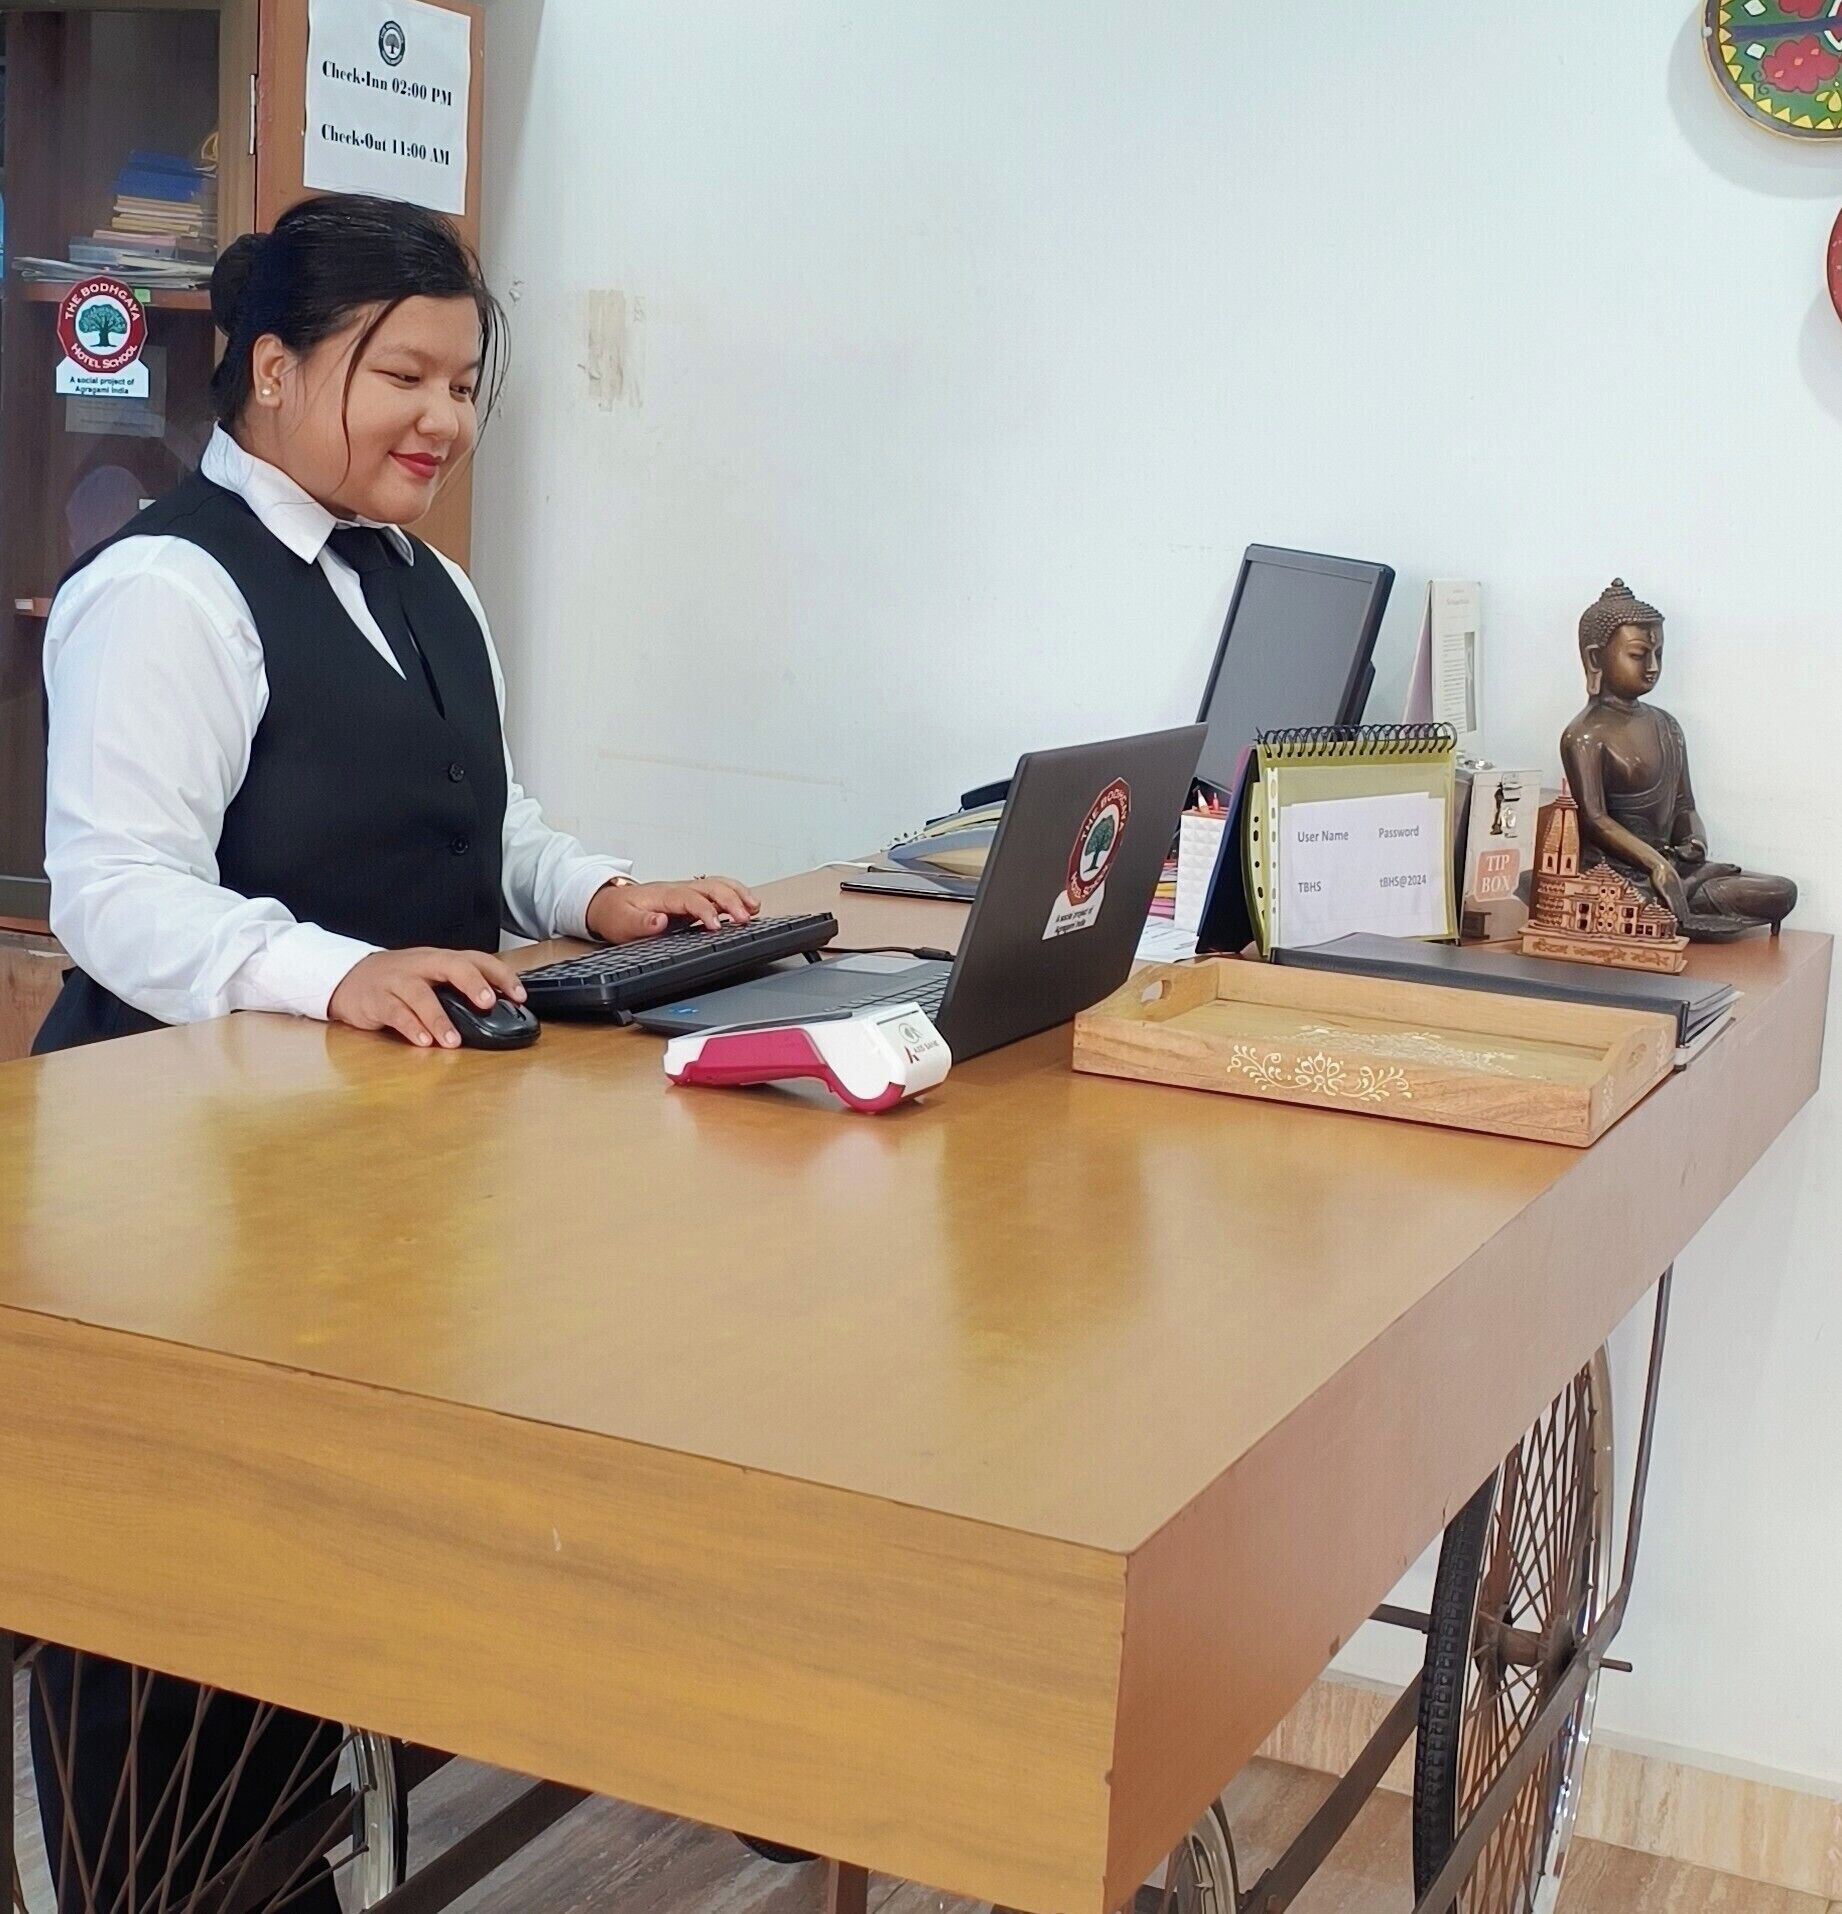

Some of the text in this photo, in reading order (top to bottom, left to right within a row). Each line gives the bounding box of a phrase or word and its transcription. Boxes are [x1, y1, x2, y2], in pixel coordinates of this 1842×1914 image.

[322, 60, 452, 106] Check-Inn 02:00 PM
[321, 123, 450, 165] Check-Out 11:00 AM
[65, 282, 141, 321] THE BODHGAYA
[70, 342, 138, 369] HOTEL SCHOOL
[77, 376, 98, 384] social
[100, 377, 126, 386] project
[1297, 830, 1349, 842] User Name
[1378, 825, 1420, 838] Password
[1486, 854, 1510, 872] TIP
[1298, 881, 1322, 893] TBHS
[1379, 874, 1427, 888] tBHS@2024
[1481, 875, 1511, 893] BOX
